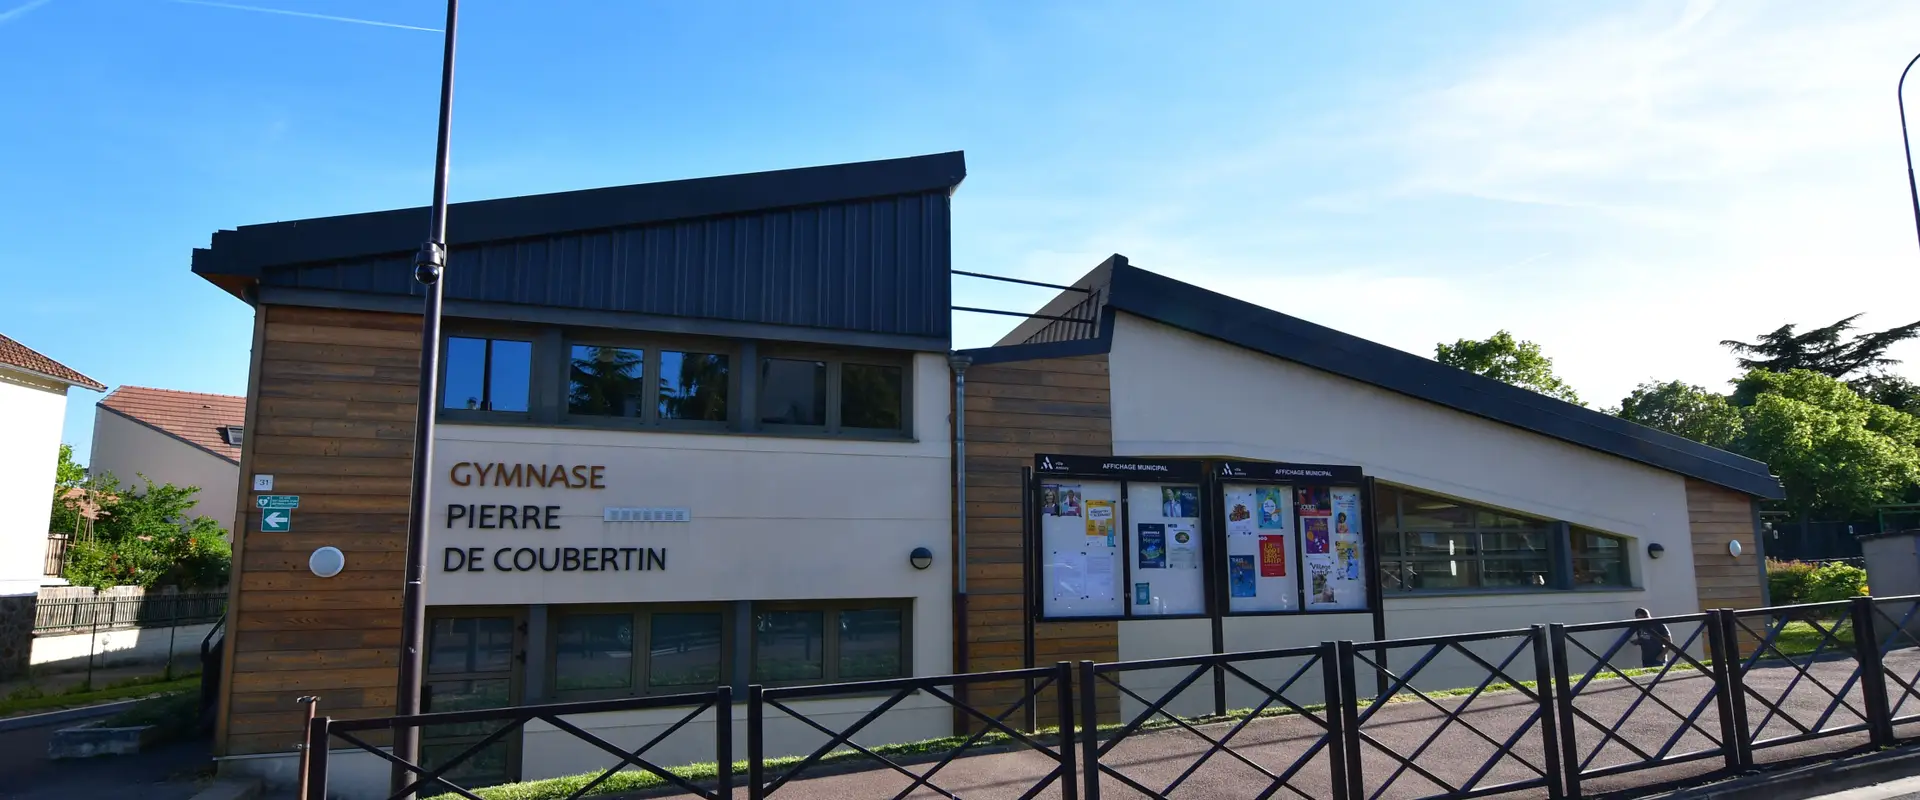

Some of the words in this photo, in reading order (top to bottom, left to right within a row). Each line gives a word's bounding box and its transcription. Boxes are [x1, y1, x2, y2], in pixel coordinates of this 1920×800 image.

[450, 462, 606, 489] GYMNASE
[446, 504, 561, 529] PIERRE
[443, 547, 485, 572] DE
[493, 547, 666, 572] COUBERTIN
